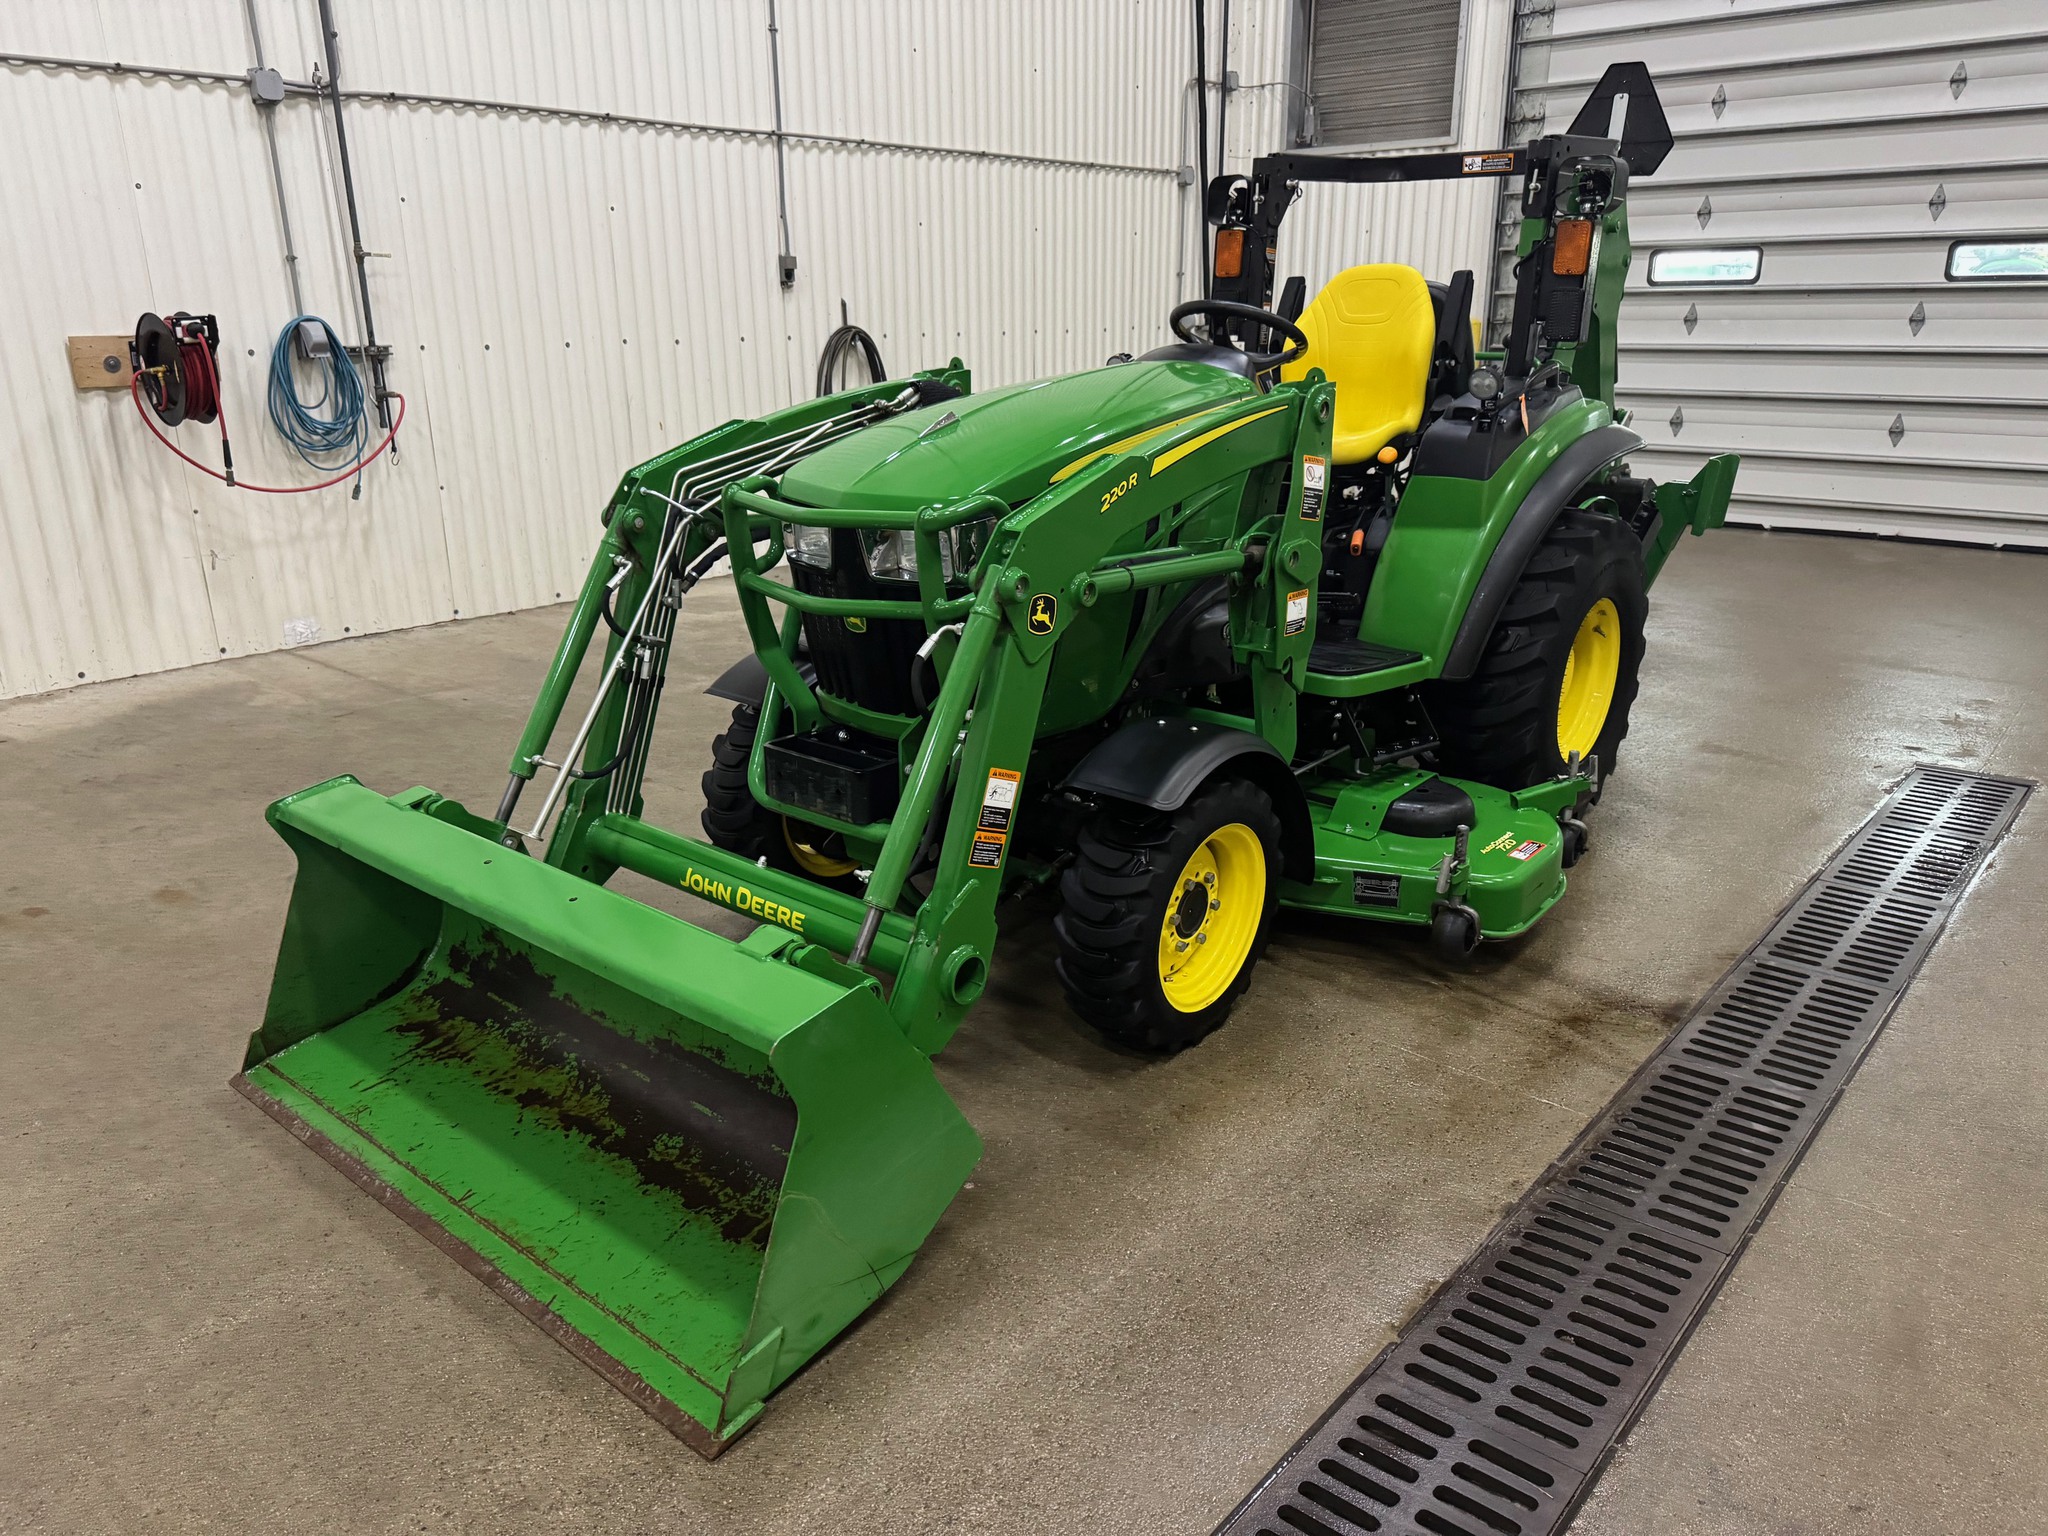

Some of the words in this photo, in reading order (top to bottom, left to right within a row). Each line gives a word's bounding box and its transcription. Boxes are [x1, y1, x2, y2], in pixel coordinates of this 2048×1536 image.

[997, 771, 1017, 779] WARNING
[680, 867, 732, 904] JOHN
[736, 886, 806, 932] DEERE
